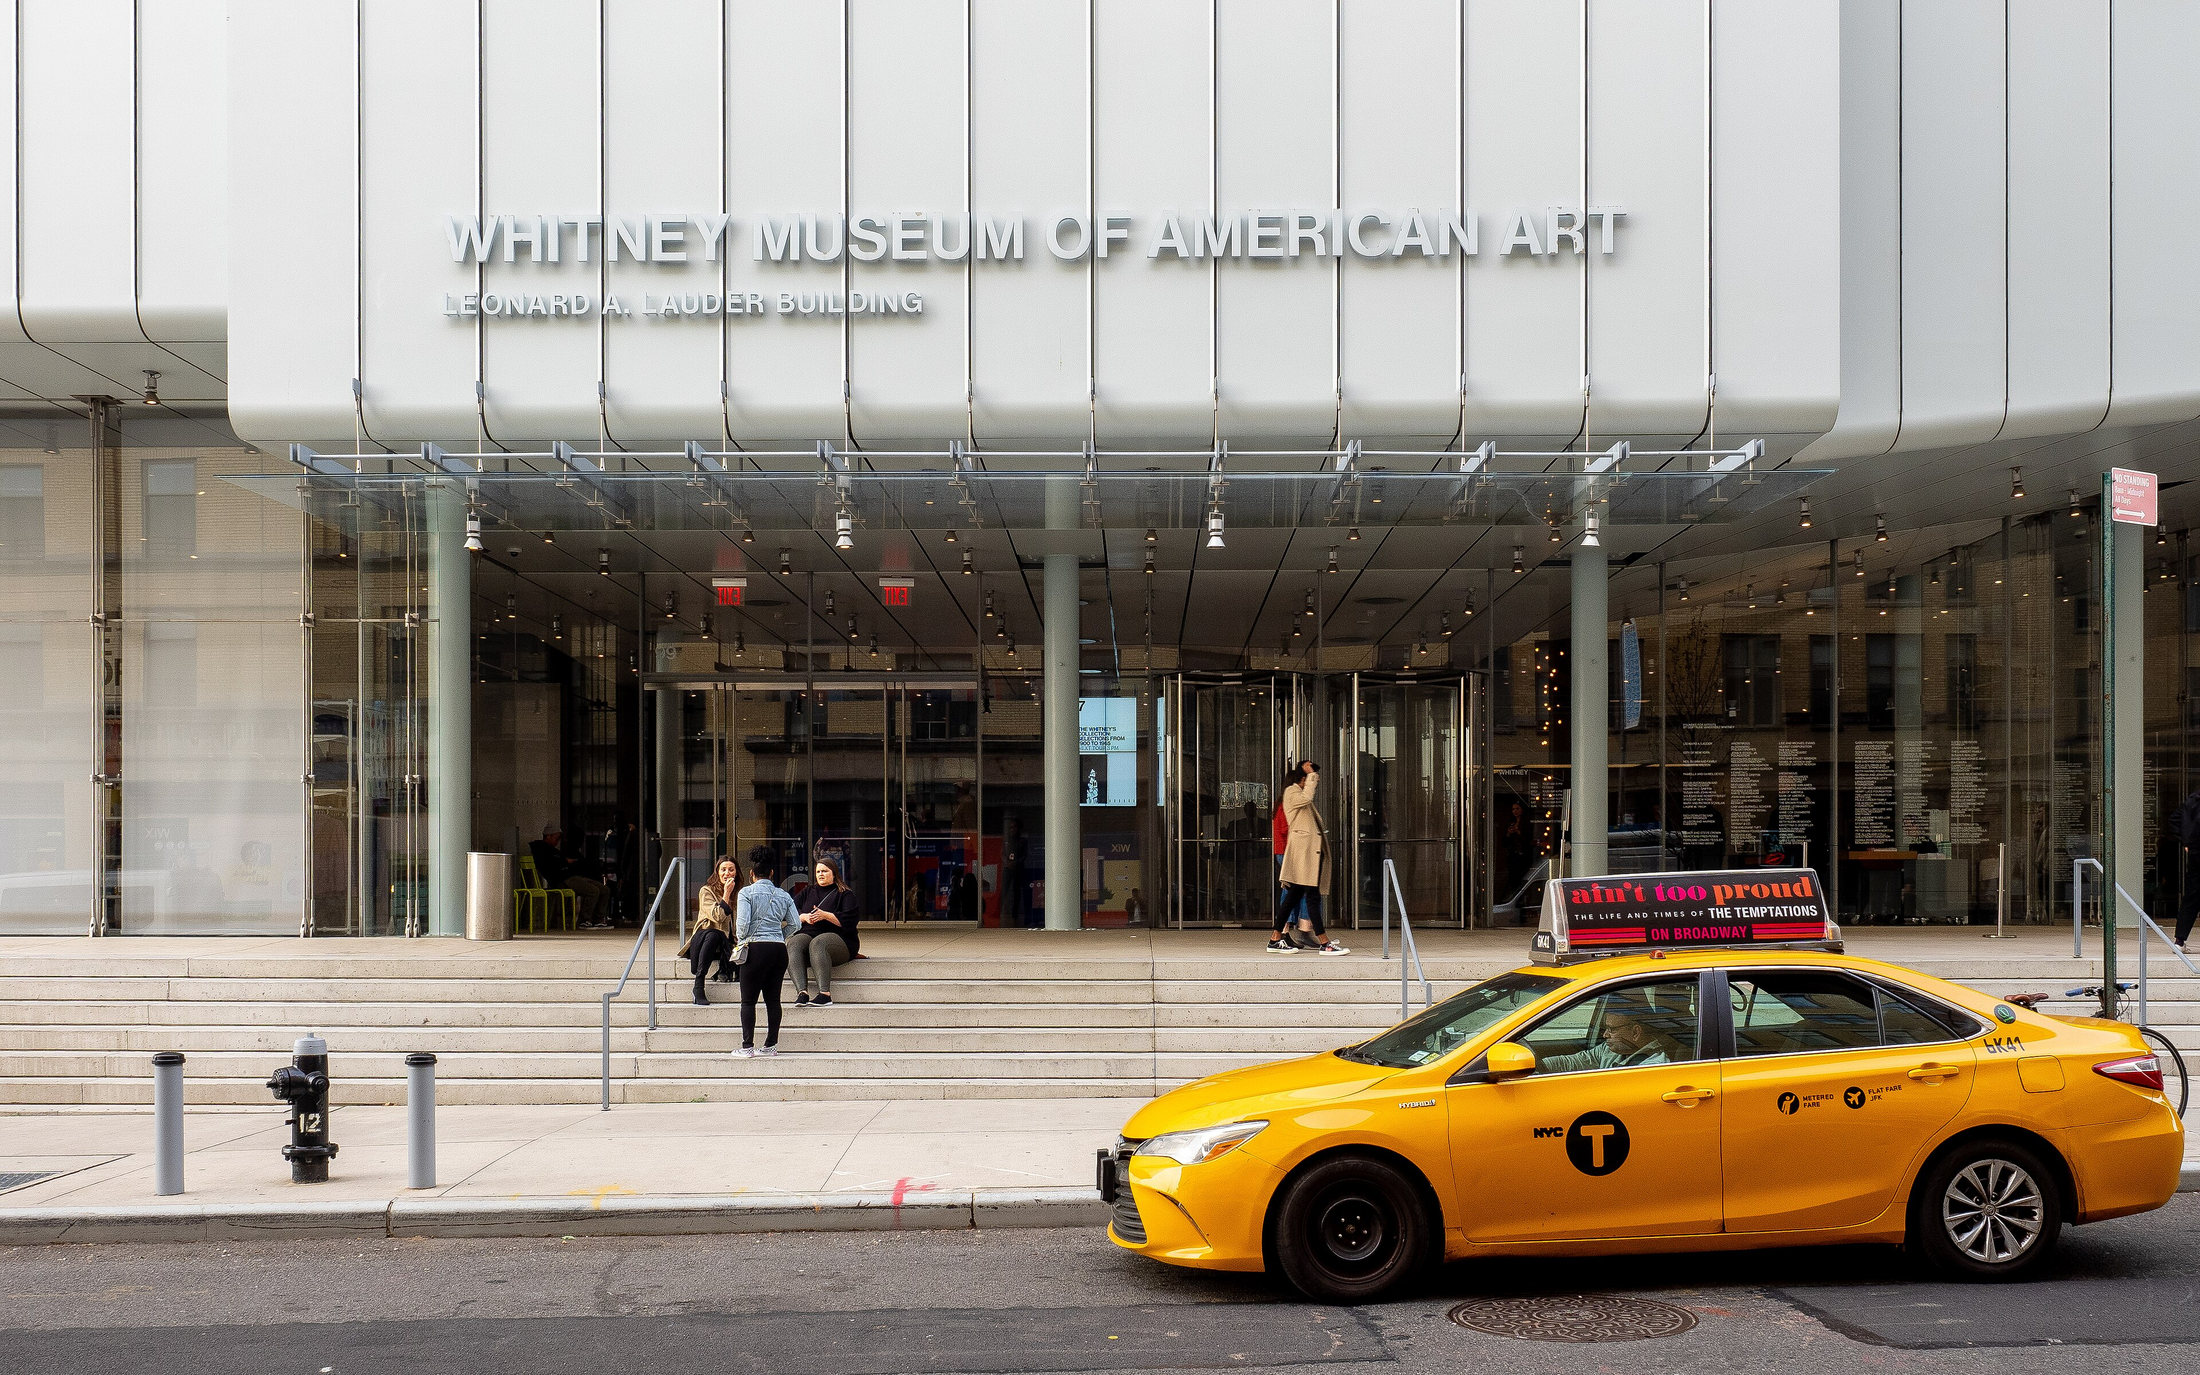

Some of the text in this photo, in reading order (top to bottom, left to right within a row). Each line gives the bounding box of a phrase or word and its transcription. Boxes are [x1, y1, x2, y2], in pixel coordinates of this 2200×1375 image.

[443, 205, 1627, 264] WHITNEY MUSEUM OF AMERICAN ART
[443, 290, 924, 316] LEONARD A. LAUDER BUILDING
[2123, 475, 2149, 487] STANDING
[1571, 876, 1814, 905] ain't too proud
[1708, 908, 1732, 919] THE
[1734, 905, 1818, 918] TEMPTATIONS
[1651, 926, 1747, 941] ON BROADWAY
[1802, 1094, 1834, 1102] METERED
[1867, 1084, 1903, 1095] FLAT FARE
[298, 1113, 322, 1134] 12
[1533, 1124, 1615, 1168] NYC T
